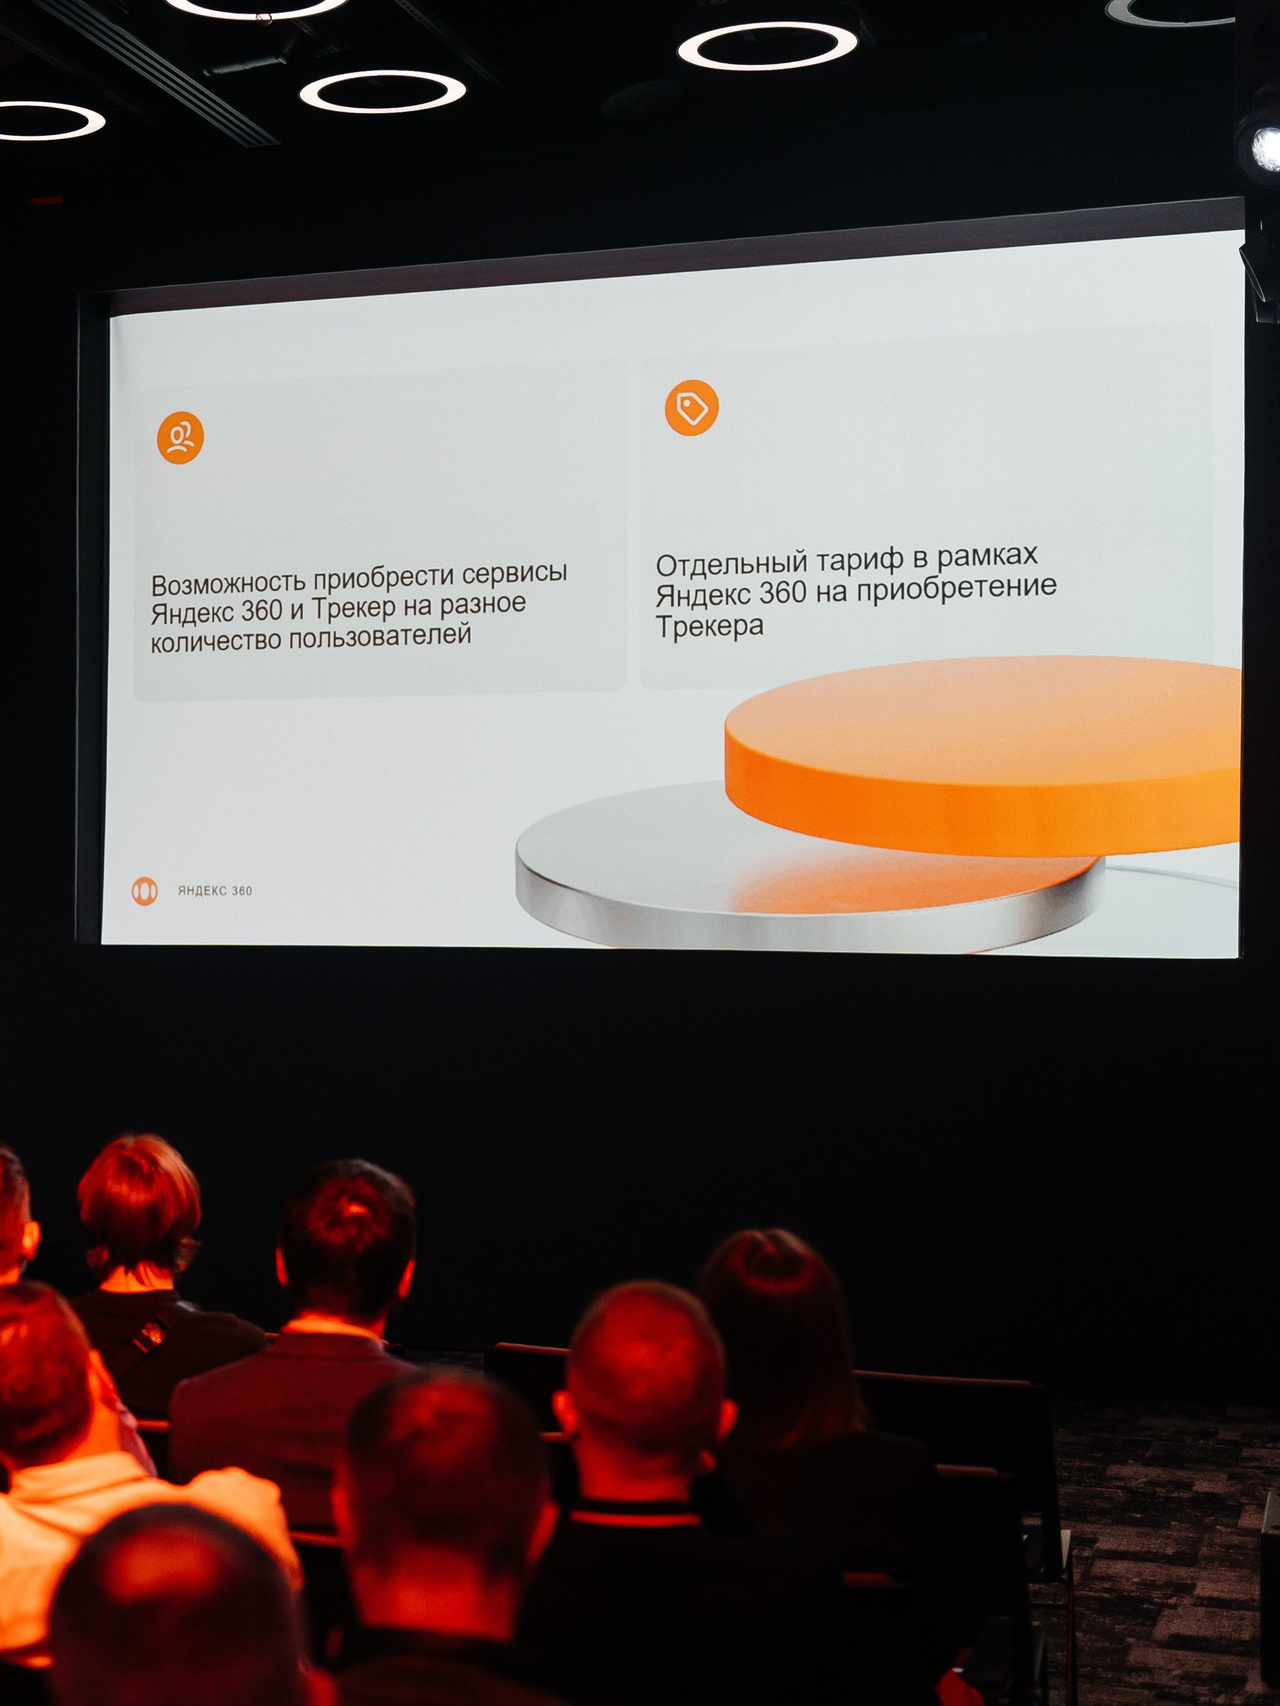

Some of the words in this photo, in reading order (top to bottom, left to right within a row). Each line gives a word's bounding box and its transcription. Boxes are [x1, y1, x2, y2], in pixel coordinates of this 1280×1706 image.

[656, 548, 807, 581] Отдельный
[816, 545, 904, 577] тариф
[913, 550, 928, 569] в
[938, 545, 1039, 574] рамках
[152, 574, 306, 597] Возможность
[314, 565, 454, 596] приобрести
[462, 563, 568, 590] сервисы
[655, 584, 751, 611] Яндекс
[759, 580, 807, 605] 360
[817, 584, 847, 603] на
[857, 575, 1058, 608] приобретение
[150, 602, 235, 628] Яндекс
[241, 598, 283, 622] 360
[291, 602, 304, 620] и
[311, 596, 396, 625] Трекер
[404, 598, 432, 616] на
[440, 595, 527, 621] разное
[151, 633, 282, 654] количество
[289, 621, 471, 649] пользователей
[655, 614, 764, 644] Трекера
[178, 885, 227, 897] ЯНДЕКС
[231, 885, 253, 896] 360
